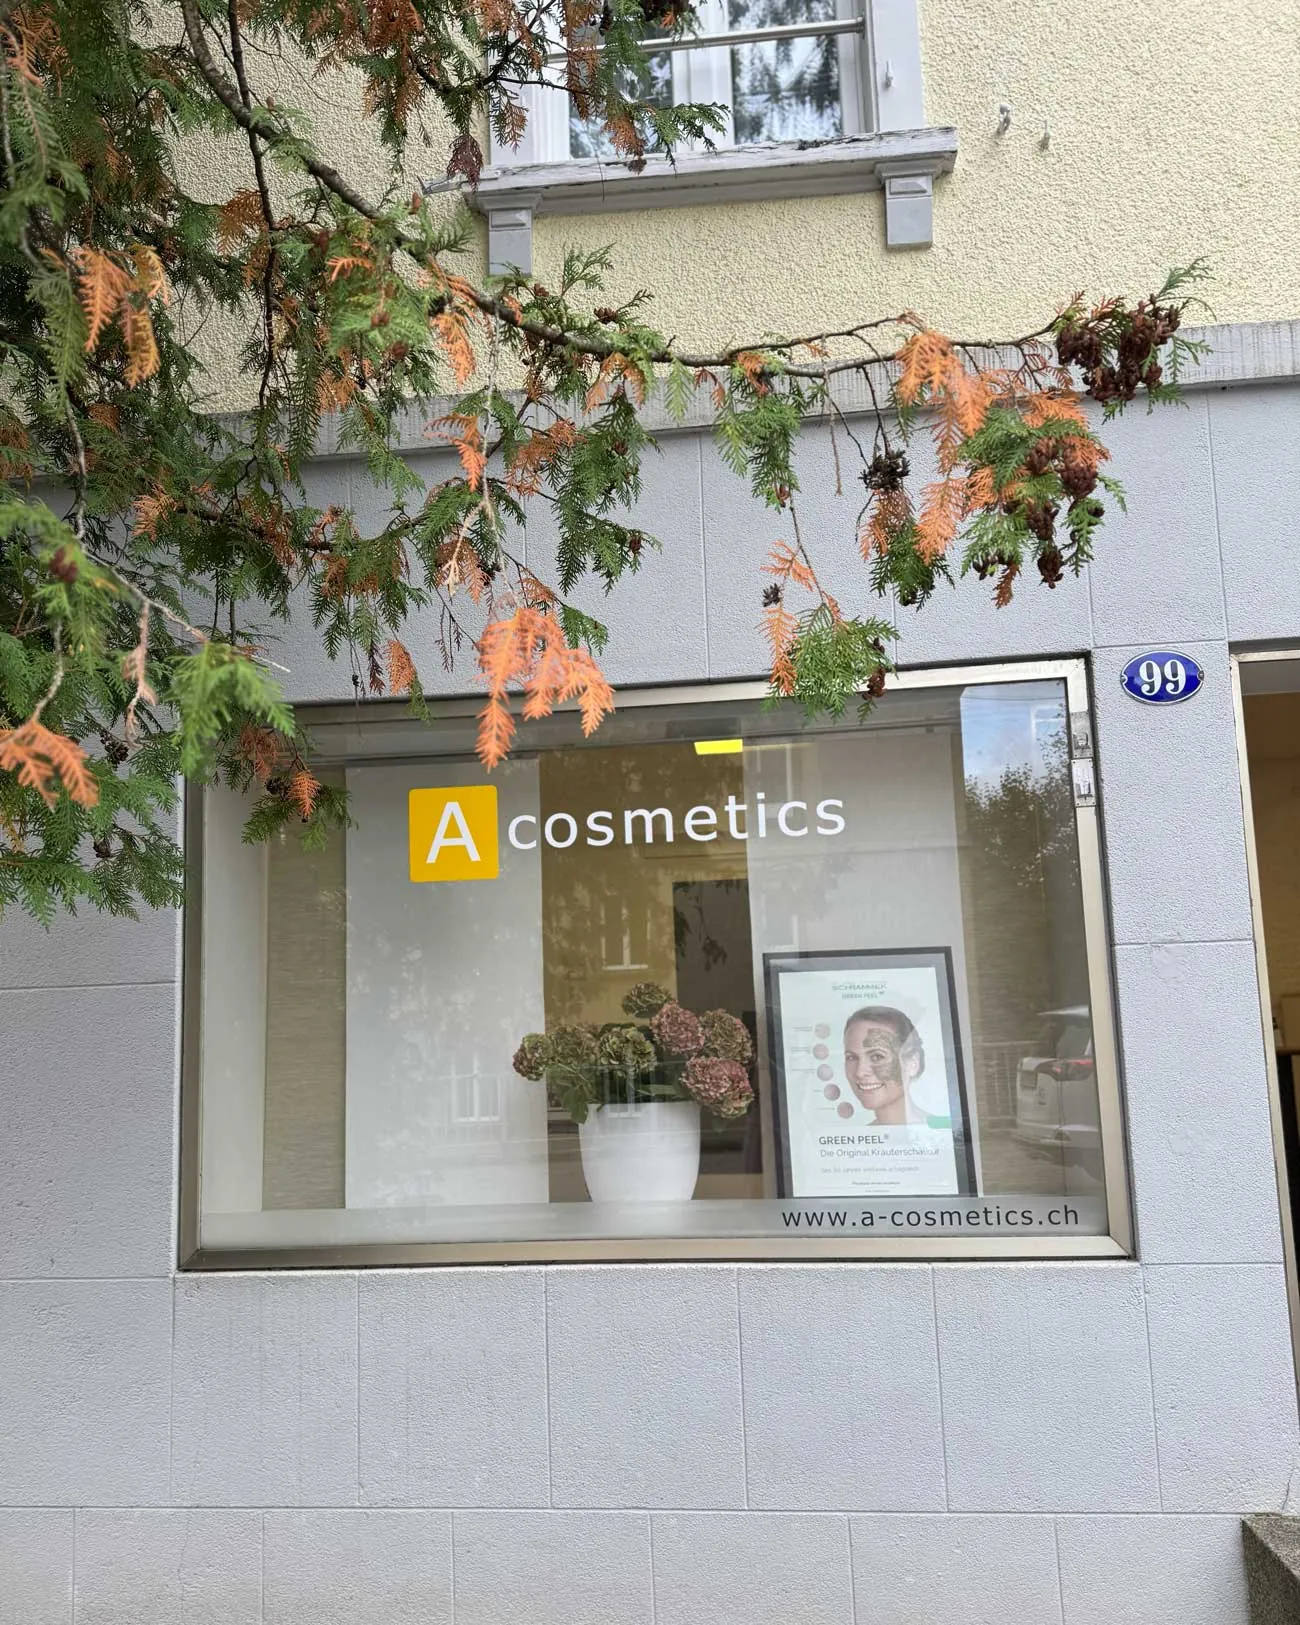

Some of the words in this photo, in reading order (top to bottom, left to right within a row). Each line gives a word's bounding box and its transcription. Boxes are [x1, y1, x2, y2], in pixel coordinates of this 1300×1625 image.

[1139, 659, 1187, 696] 99
[425, 800, 482, 864] A
[507, 792, 847, 851] cosmetics
[819, 1136, 855, 1145] GREEN
[820, 1149, 835, 1158] Die
[836, 1148, 870, 1158] Original
[782, 1205, 1080, 1227] www.a-cosmetics.ch
